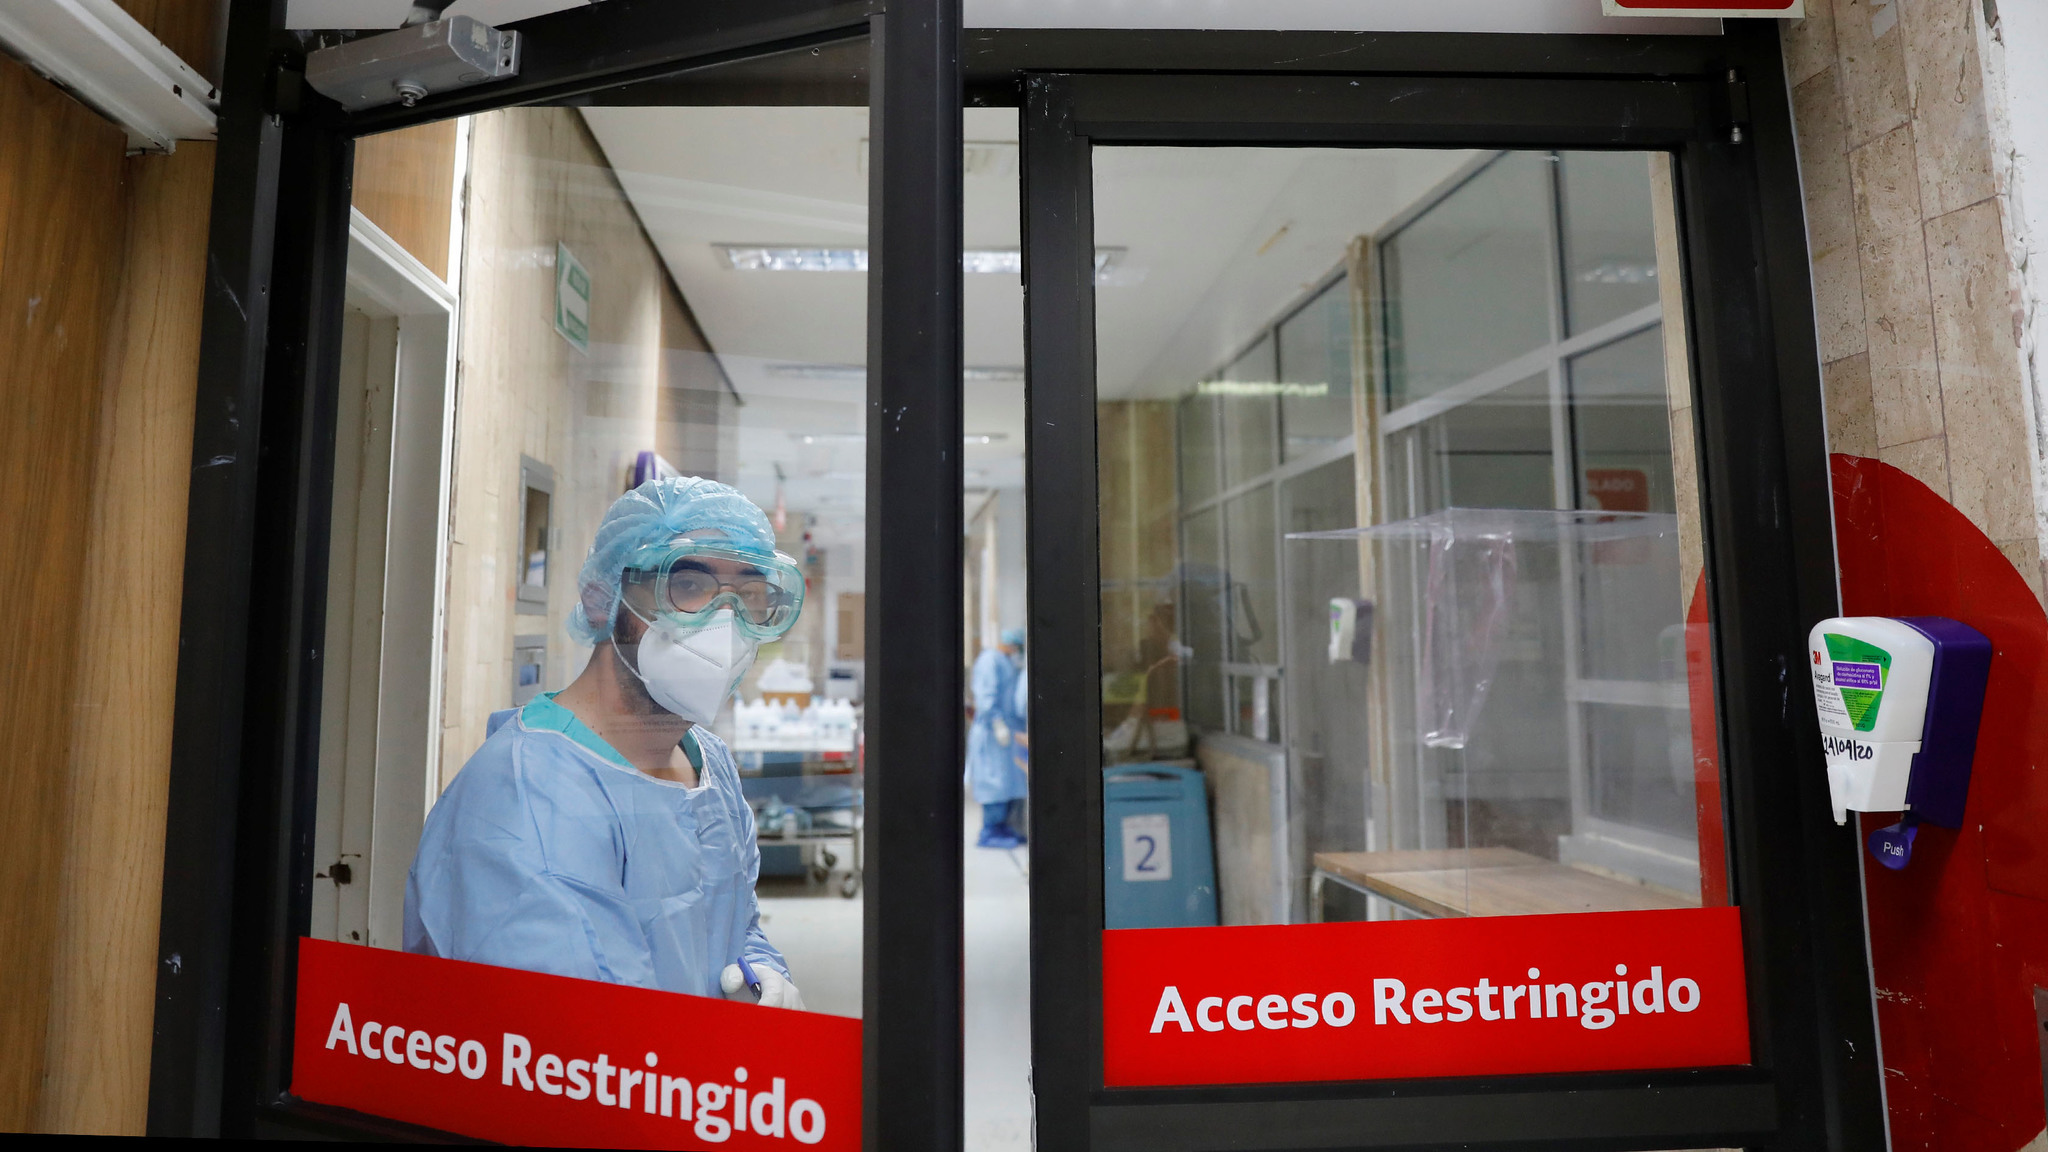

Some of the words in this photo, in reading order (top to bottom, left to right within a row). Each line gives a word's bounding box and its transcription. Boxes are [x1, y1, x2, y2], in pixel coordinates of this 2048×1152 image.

[1813, 651, 1821, 665] 3M
[1136, 835, 1156, 872] 2
[1883, 841, 1904, 857] Push
[1149, 986, 1356, 1034] Acceso
[1373, 963, 1701, 1030] Restringido
[325, 1002, 487, 1080] Acceso
[501, 1032, 826, 1144] Restringido
